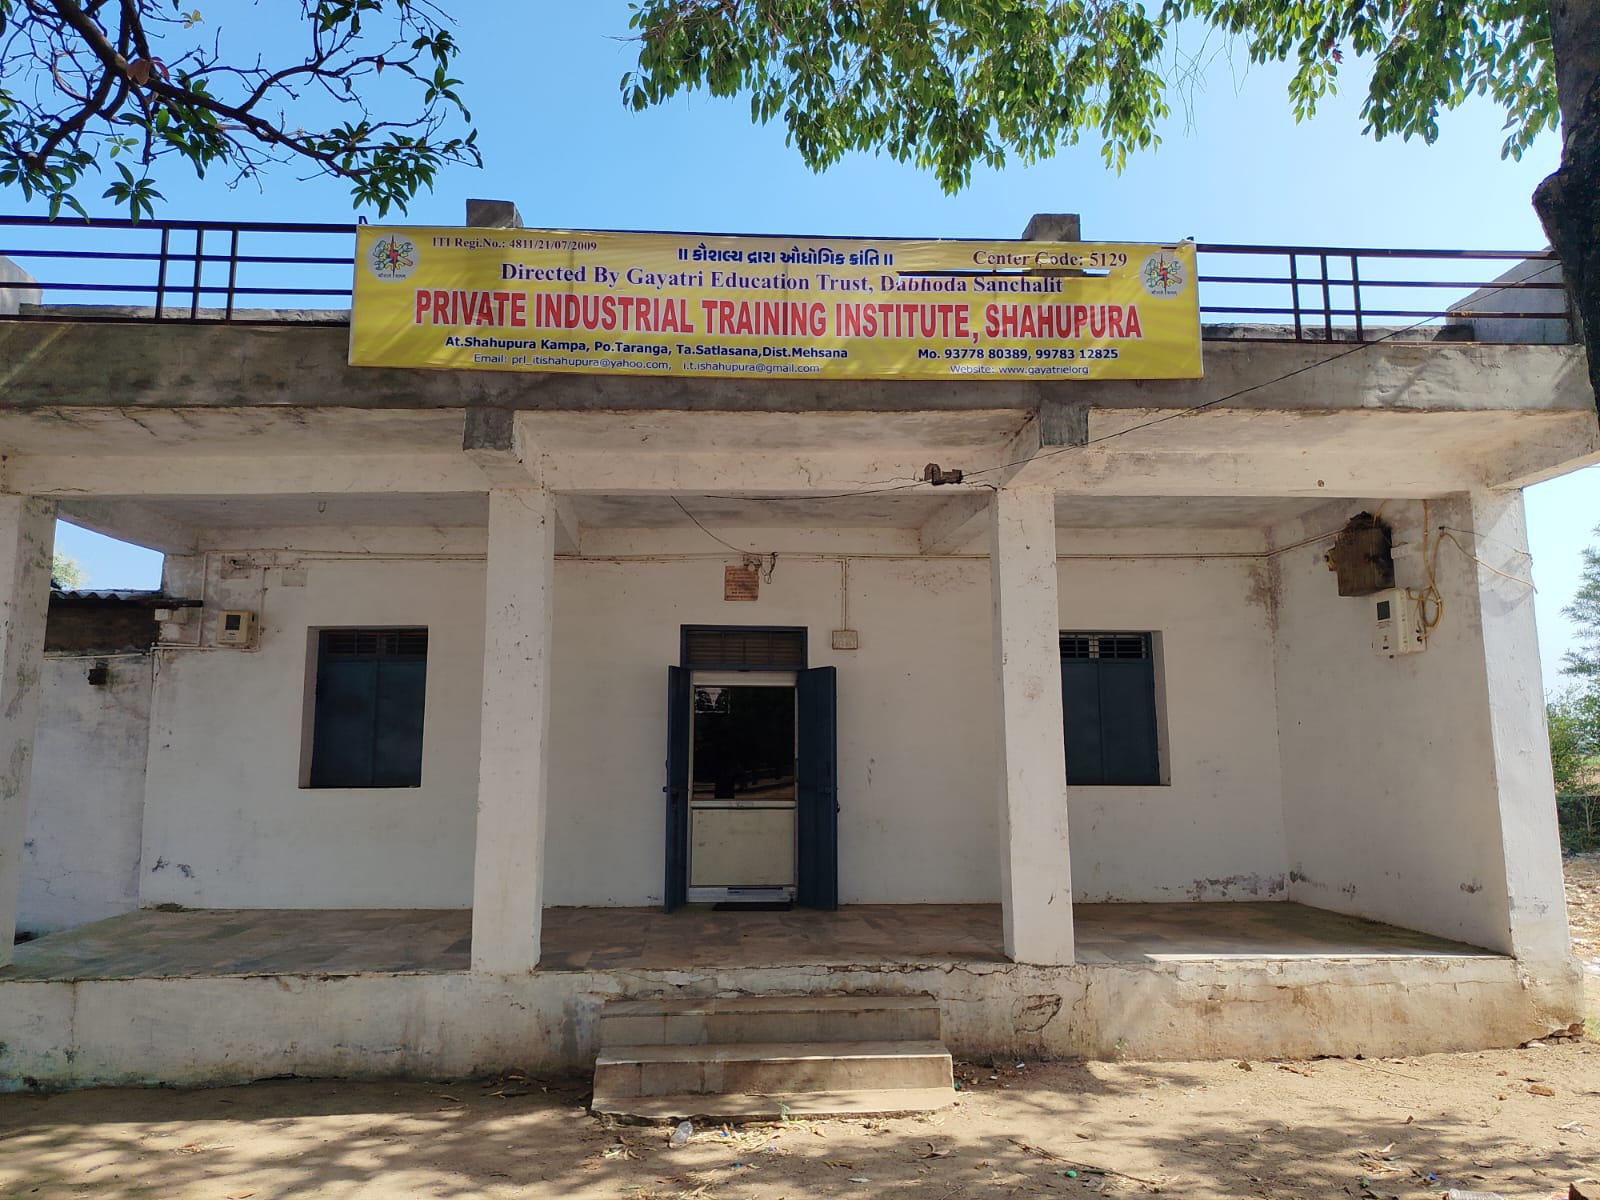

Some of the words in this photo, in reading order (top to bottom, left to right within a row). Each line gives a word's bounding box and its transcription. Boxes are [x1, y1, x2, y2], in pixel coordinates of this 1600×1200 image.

[432, 237, 450, 247] ITI
[509, 239, 597, 251] 4811/21/07/2009
[973, 250, 1030, 266] Center
[1035, 251, 1083, 267] Code:
[1089, 252, 1127, 267] 5129
[501, 263, 586, 282] Directed
[594, 266, 620, 288] By
[626, 267, 703, 290] Gayatri
[711, 271, 809, 291] Education
[816, 274, 874, 294] Trust,
[880, 276, 967, 292] Dabhoda
[973, 277, 1062, 293] Sanchalit
[415, 290, 526, 327] PRIVATE
[535, 293, 694, 333] INDUSTRIAL
[701, 300, 827, 337] TRAINING
[836, 303, 979, 344] INSTITUTE,
[985, 304, 1142, 338] SHAHUPURA
[445, 336, 536, 350] At.Shahupura
[540, 340, 590, 352] Kampa,
[594, 341, 672, 356] Po.Taranga,
[676, 344, 848, 359] Ta.Satlasana,Dist.Mehsana
[918, 349, 941, 359] Mo.
[944, 349, 985, 359] 93778
[988, 349, 1031, 361] 80389,
[1035, 349, 1075, 359] 99783
[1079, 349, 1118, 359] 12825
[474, 353, 507, 363] Email:
